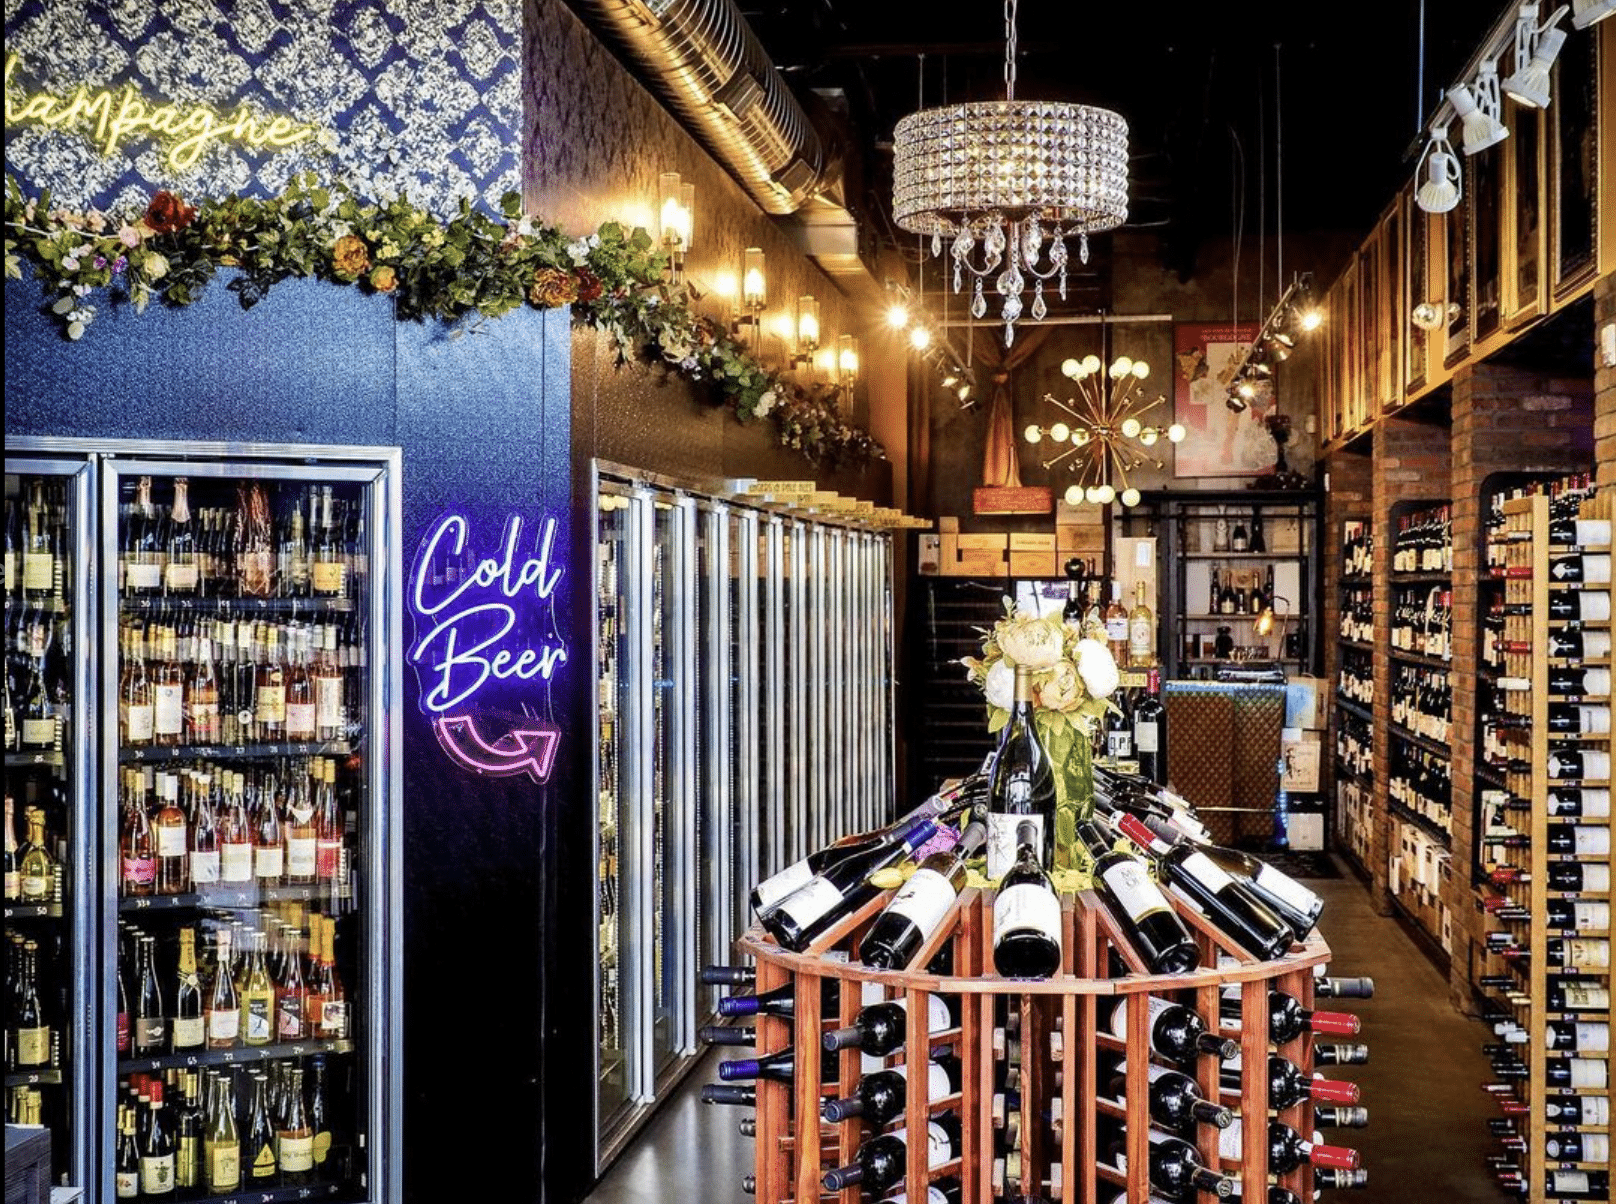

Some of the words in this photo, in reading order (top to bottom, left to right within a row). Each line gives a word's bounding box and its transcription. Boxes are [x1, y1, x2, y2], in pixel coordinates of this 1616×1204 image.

[414, 515, 562, 615] Cold
[413, 603, 567, 711] Beer
[36, 906, 48, 916] 50
